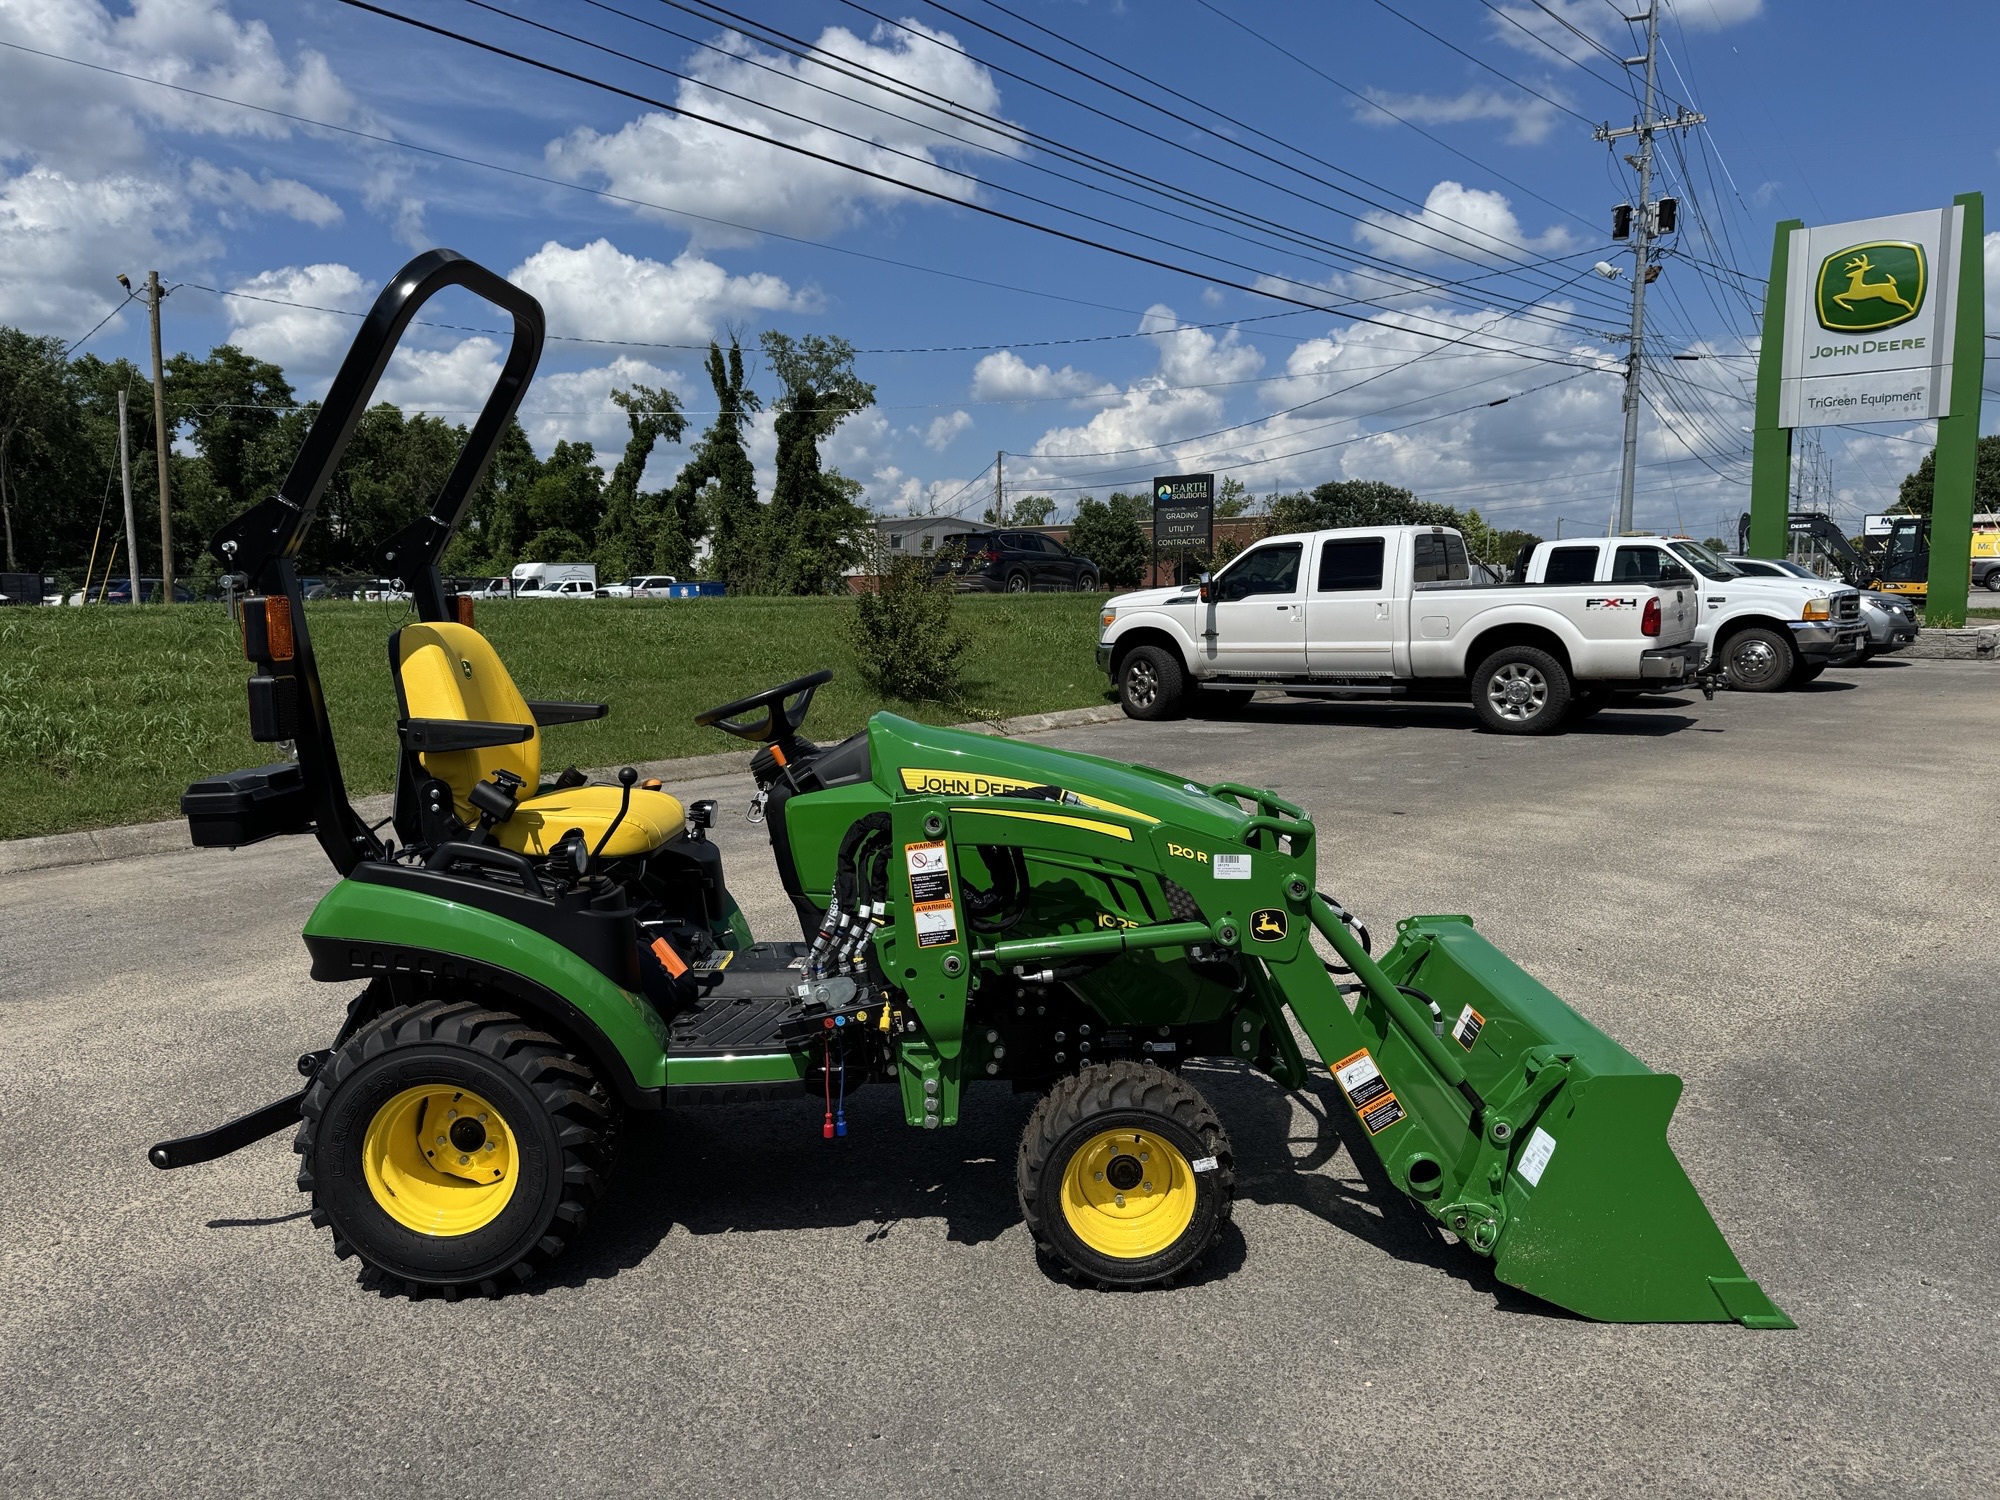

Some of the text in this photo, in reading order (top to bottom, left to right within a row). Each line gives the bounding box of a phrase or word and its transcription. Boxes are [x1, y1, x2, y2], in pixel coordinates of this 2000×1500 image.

[1809, 337, 1926, 360] JOHN DEERE
[1808, 391, 1922, 409] TriGreen Equipment
[1172, 482, 1207, 494] EARTH
[1171, 491, 1208, 500] solutions
[1165, 511, 1199, 520] GRADING
[1168, 525, 1195, 533] UTILITY
[1157, 538, 1206, 547] CONTRACTOR
[1586, 598, 1637, 608] FX4
[917, 775, 969, 794] JOHN
[912, 840, 944, 851] WARNING
[1167, 842, 1208, 864] 120 R
[920, 902, 952, 912] WARNING
[1340, 1051, 1365, 1067] WARNING
[1368, 1096, 1392, 1111] WARNING
[329, 1071, 394, 1178] CARLSTAR
